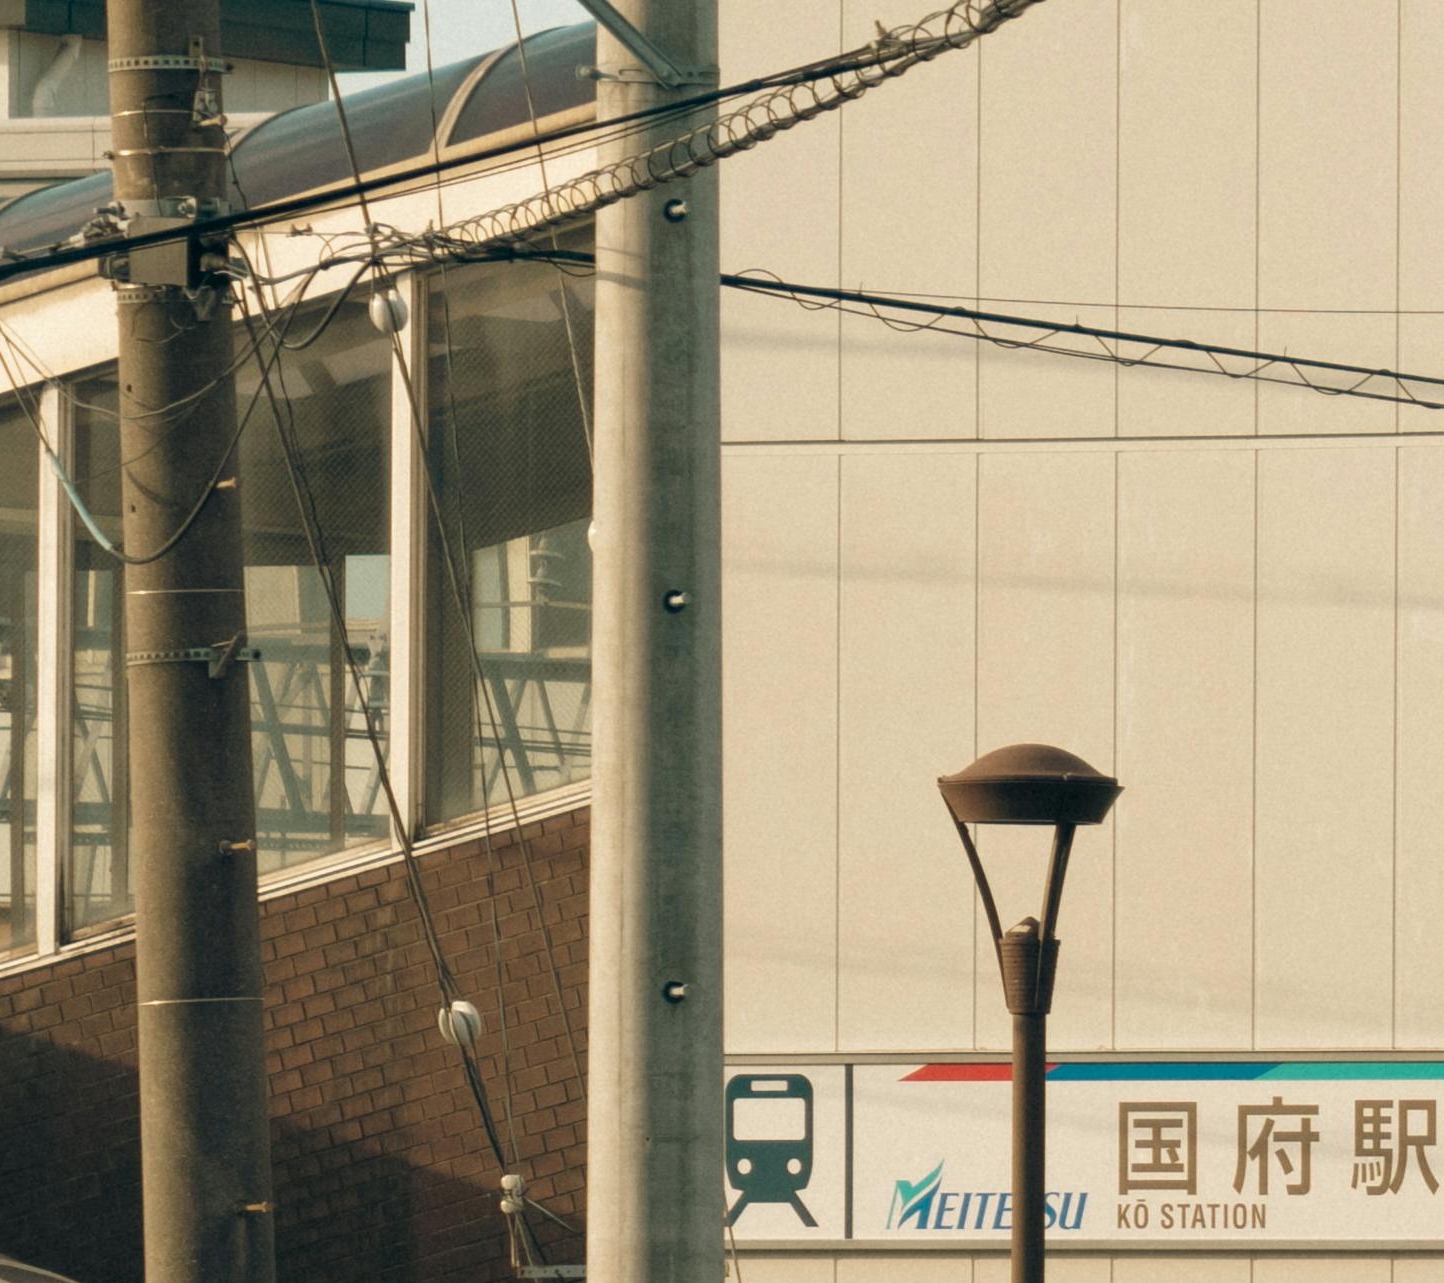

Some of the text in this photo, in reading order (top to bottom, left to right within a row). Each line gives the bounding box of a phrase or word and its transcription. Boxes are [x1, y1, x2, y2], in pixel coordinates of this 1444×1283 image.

[1118, 1096, 1440, 1196] 国府駅
[885, 1157, 1089, 1230] MEITESU
[1117, 1199, 1267, 1230] KŌ STATION
